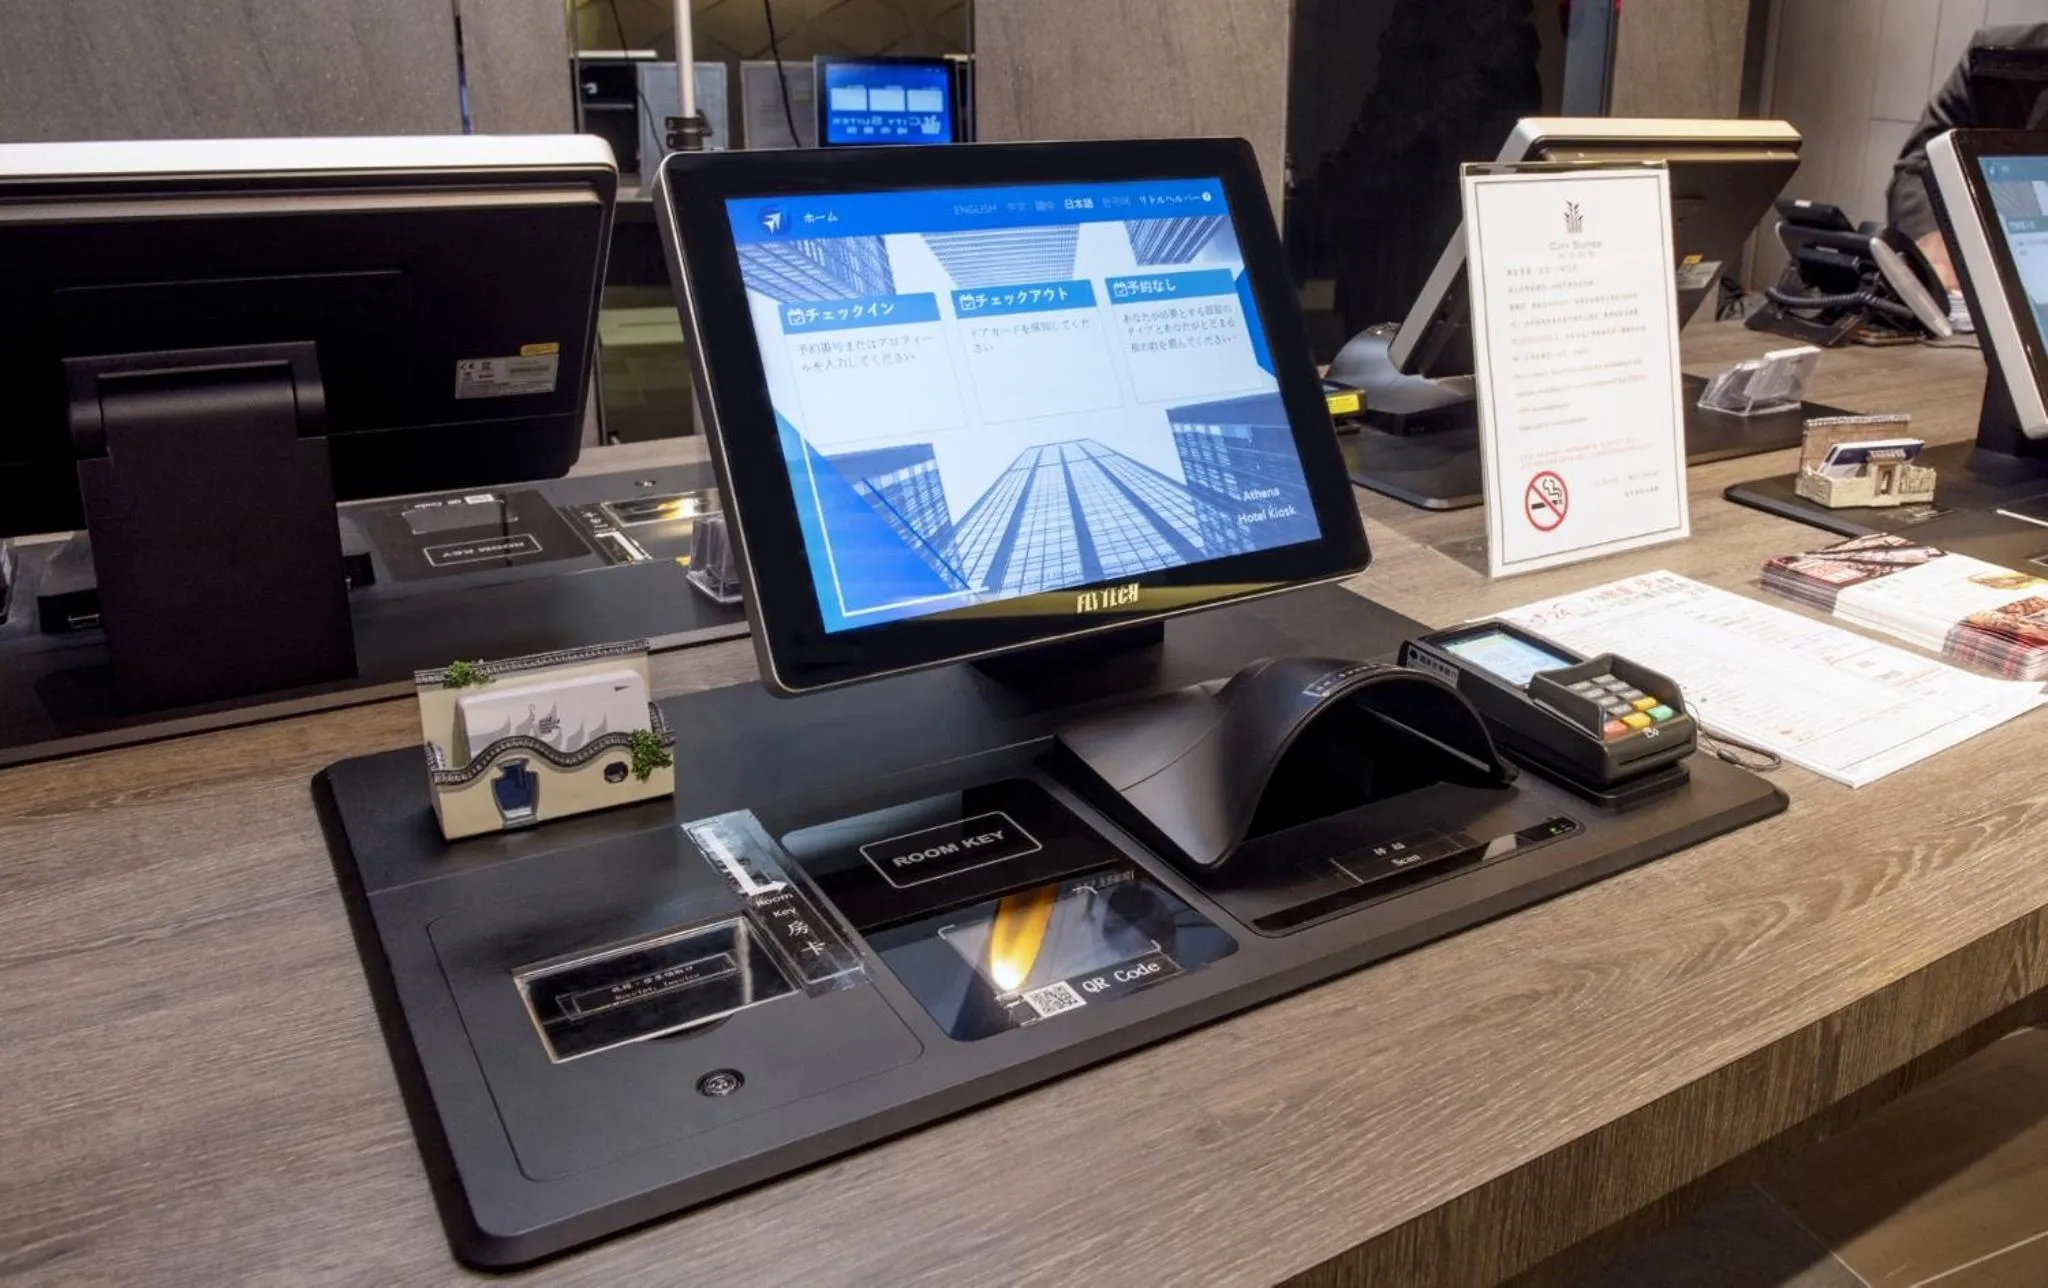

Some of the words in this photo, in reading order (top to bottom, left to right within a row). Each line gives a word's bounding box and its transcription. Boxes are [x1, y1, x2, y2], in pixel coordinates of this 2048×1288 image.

[1064, 198, 1094, 210] 日本語
[974, 287, 1069, 308] チェックアウト
[805, 302, 895, 323] チェックイン
[1243, 487, 1280, 502] Athena
[1238, 509, 1267, 525] Hotel
[1267, 504, 1297, 519] Kiosk
[892, 842, 960, 868] ROOM
[961, 829, 1005, 849] KEY
[755, 892, 794, 908] Room
[772, 906, 797, 919] Key
[1081, 976, 1112, 994] QR
[1113, 961, 1161, 983] Code
